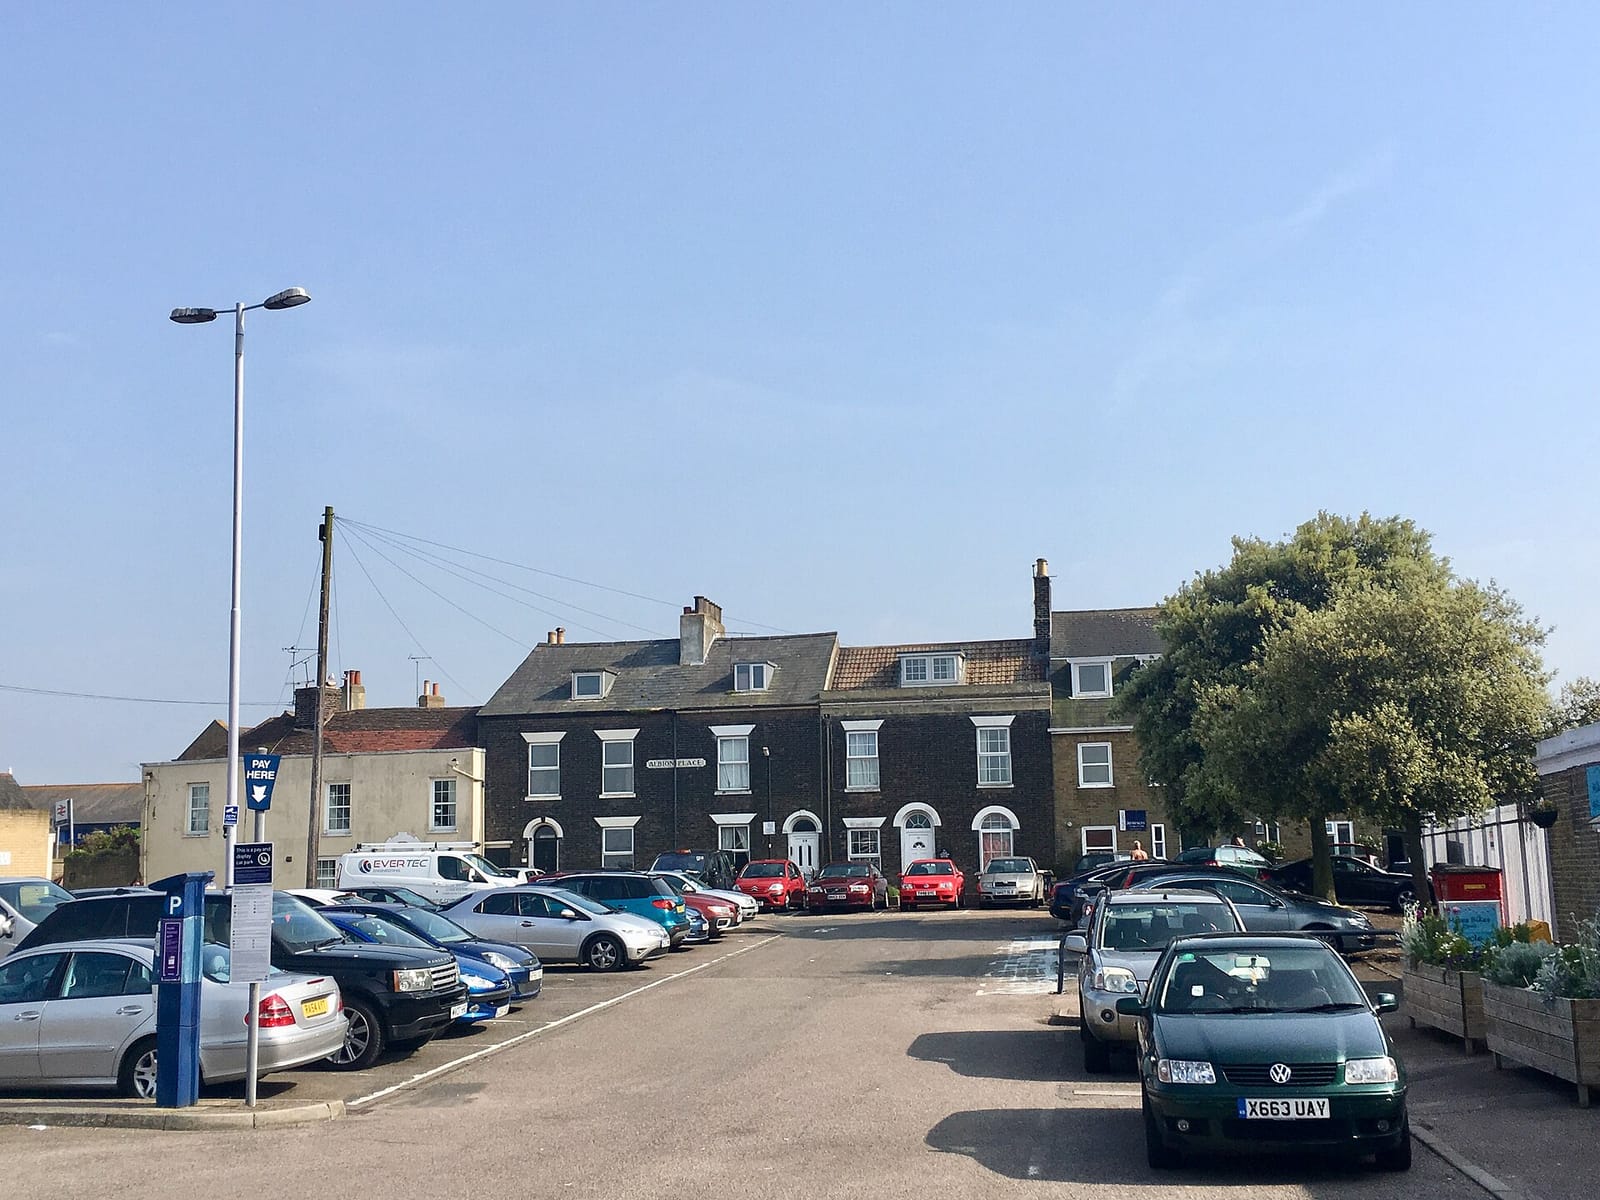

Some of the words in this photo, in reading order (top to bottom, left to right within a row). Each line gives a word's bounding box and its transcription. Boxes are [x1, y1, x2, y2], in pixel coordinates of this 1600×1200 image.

[252, 760, 271, 769] PAY
[246, 770, 276, 780] HERE
[373, 859, 428, 868] EVERTEC
[169, 896, 182, 915] P
[1249, 1101, 1291, 1117] X663
[1295, 1101, 1326, 1117] UAY
